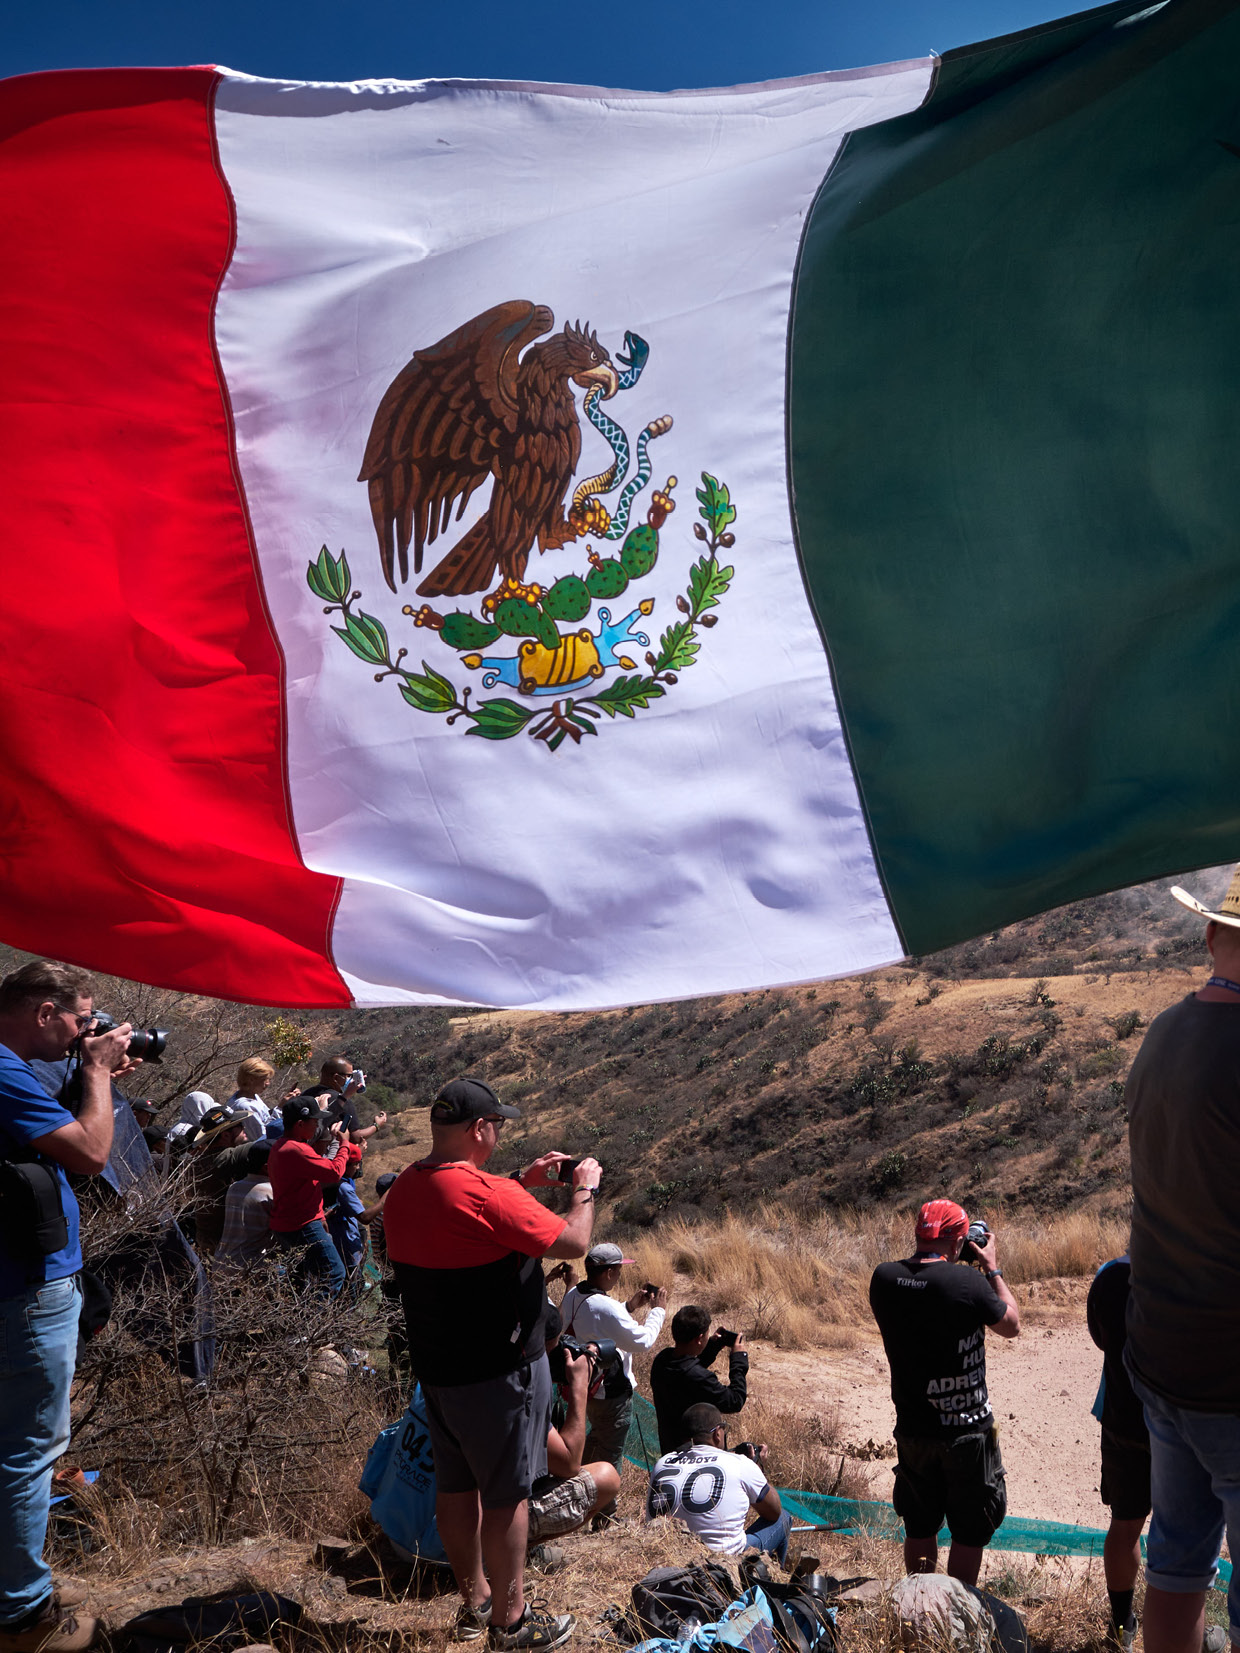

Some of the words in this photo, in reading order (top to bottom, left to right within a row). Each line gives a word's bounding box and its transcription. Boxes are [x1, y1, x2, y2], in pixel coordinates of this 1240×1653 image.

[896, 1277, 928, 1289] Turkey
[664, 1455, 719, 1465] COWBOYS
[647, 1466, 725, 1520] 60
